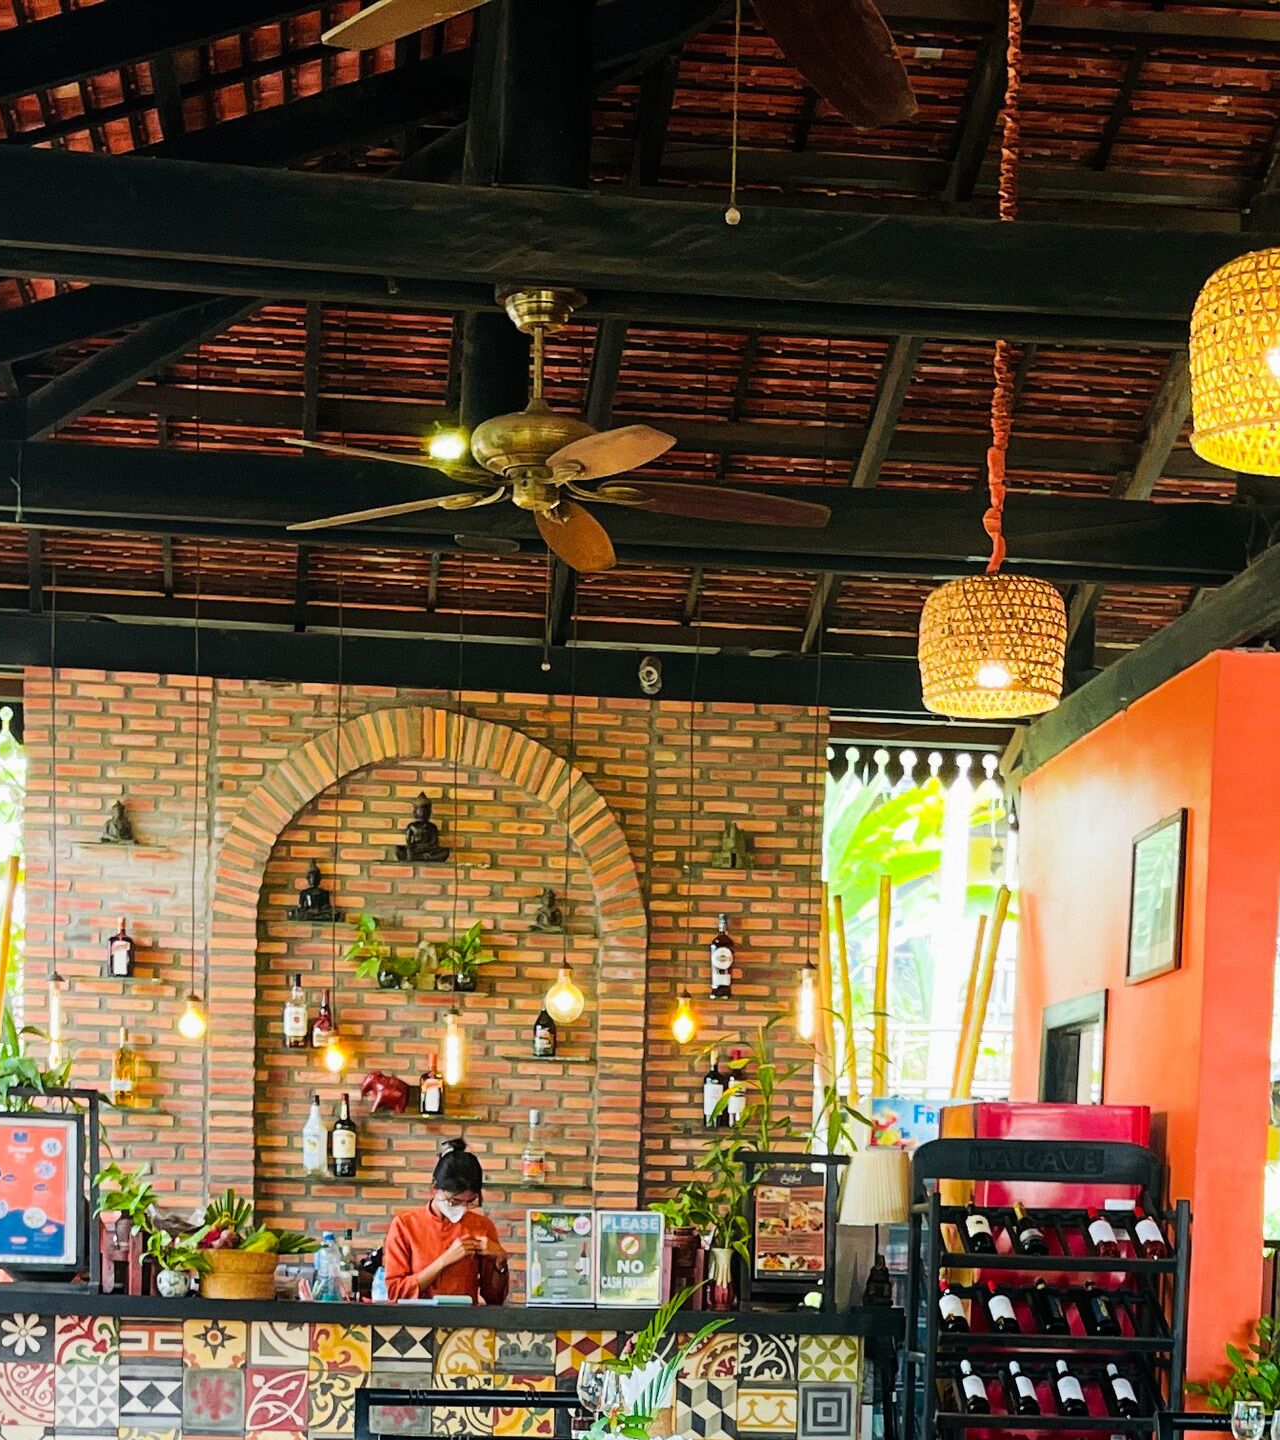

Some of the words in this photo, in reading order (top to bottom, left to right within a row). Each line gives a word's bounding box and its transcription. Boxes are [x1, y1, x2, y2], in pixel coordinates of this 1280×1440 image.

[1022, 1151, 1099, 1172] CAVE
[602, 1217, 658, 1230] PLEASE
[617, 1260, 644, 1273] NO
[601, 1276, 622, 1289] CASH
